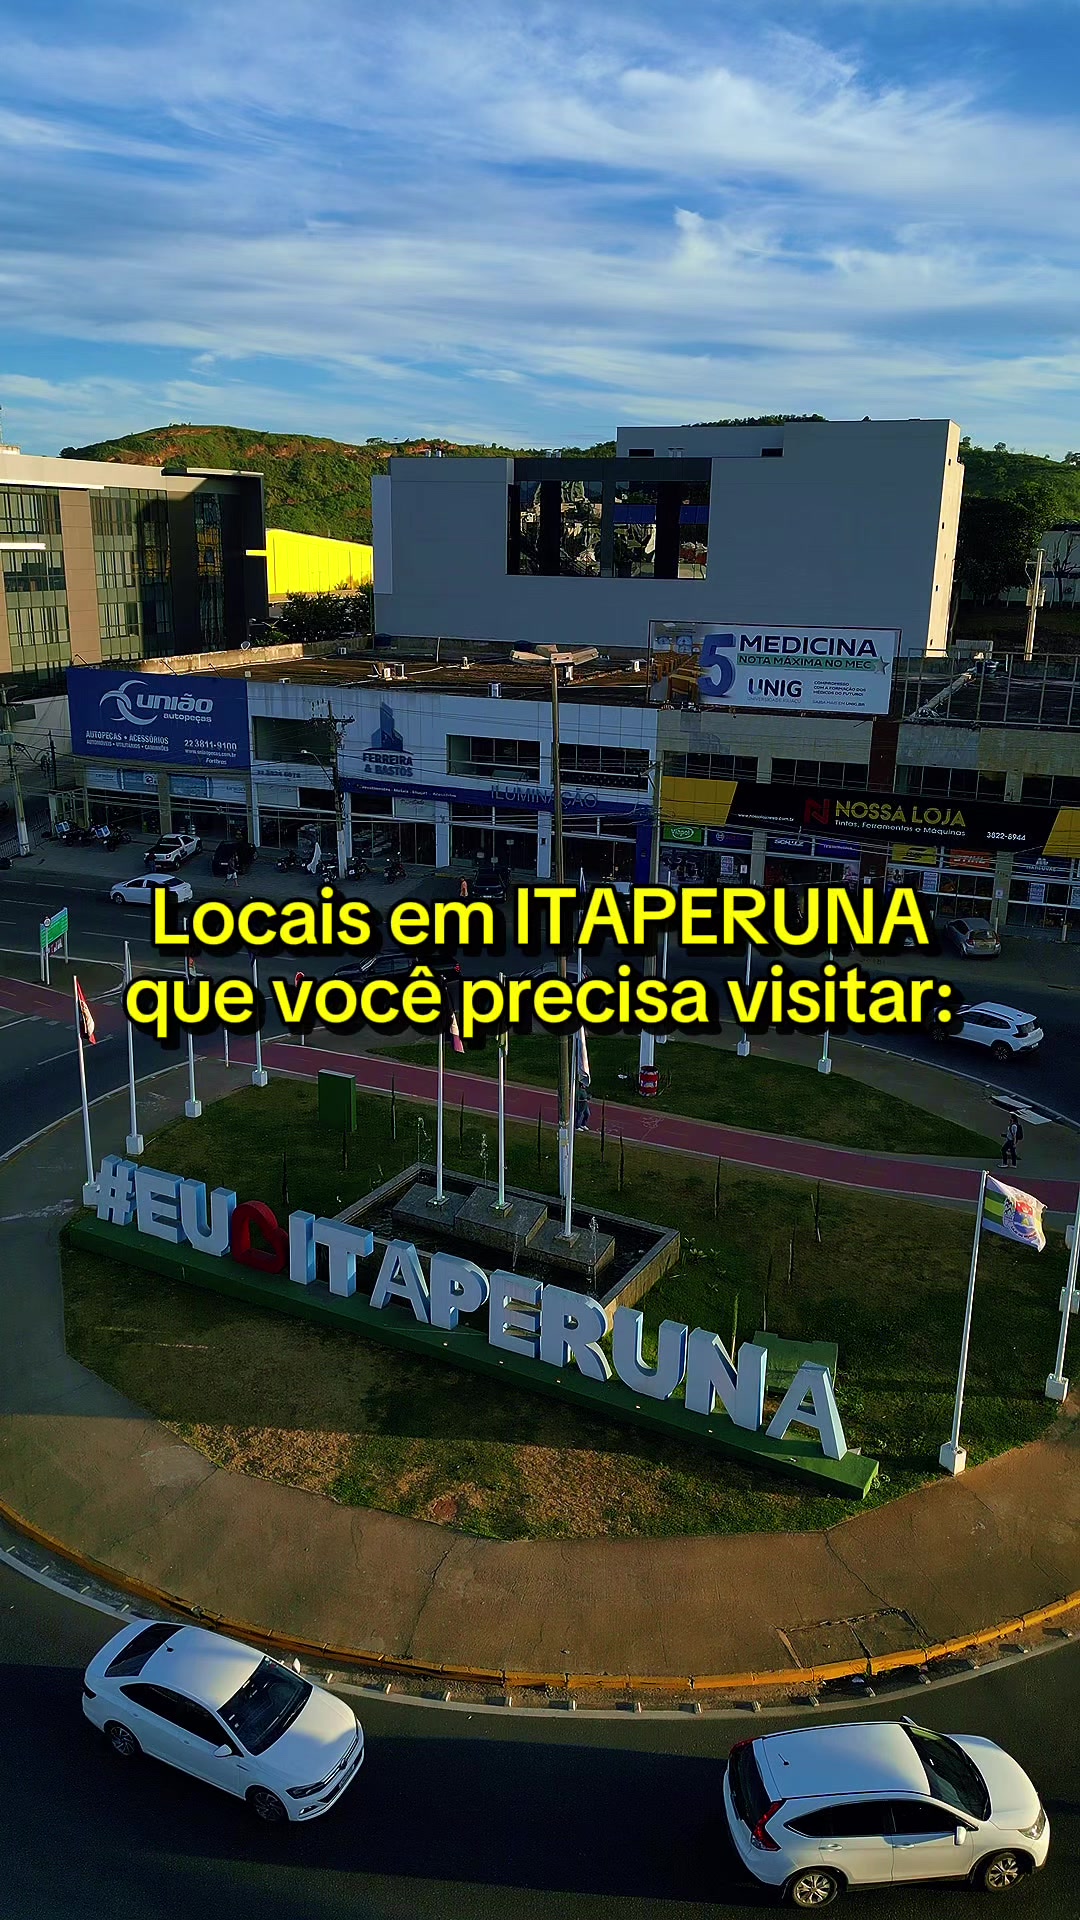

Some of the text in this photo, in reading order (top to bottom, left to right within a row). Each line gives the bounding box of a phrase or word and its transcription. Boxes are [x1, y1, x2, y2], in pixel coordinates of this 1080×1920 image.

[739, 634, 878, 657] MEDICINA
[698, 633, 736, 698] 5
[739, 655, 872, 672] NOTA MÁXIMA NO MEC
[748, 678, 803, 697] UNIG
[136, 692, 214, 713] união
[163, 713, 212, 724] autopeças
[129, 734, 168, 745] ACESSÓRIOS
[362, 752, 414, 766] FERREIRA
[364, 764, 414, 777] & BASTOS
[835, 800, 967, 828] NOSSA LOJA
[923, 826, 966, 837] Máquinas
[95, 1154, 847, 1462] #EU ITAPERUNA
